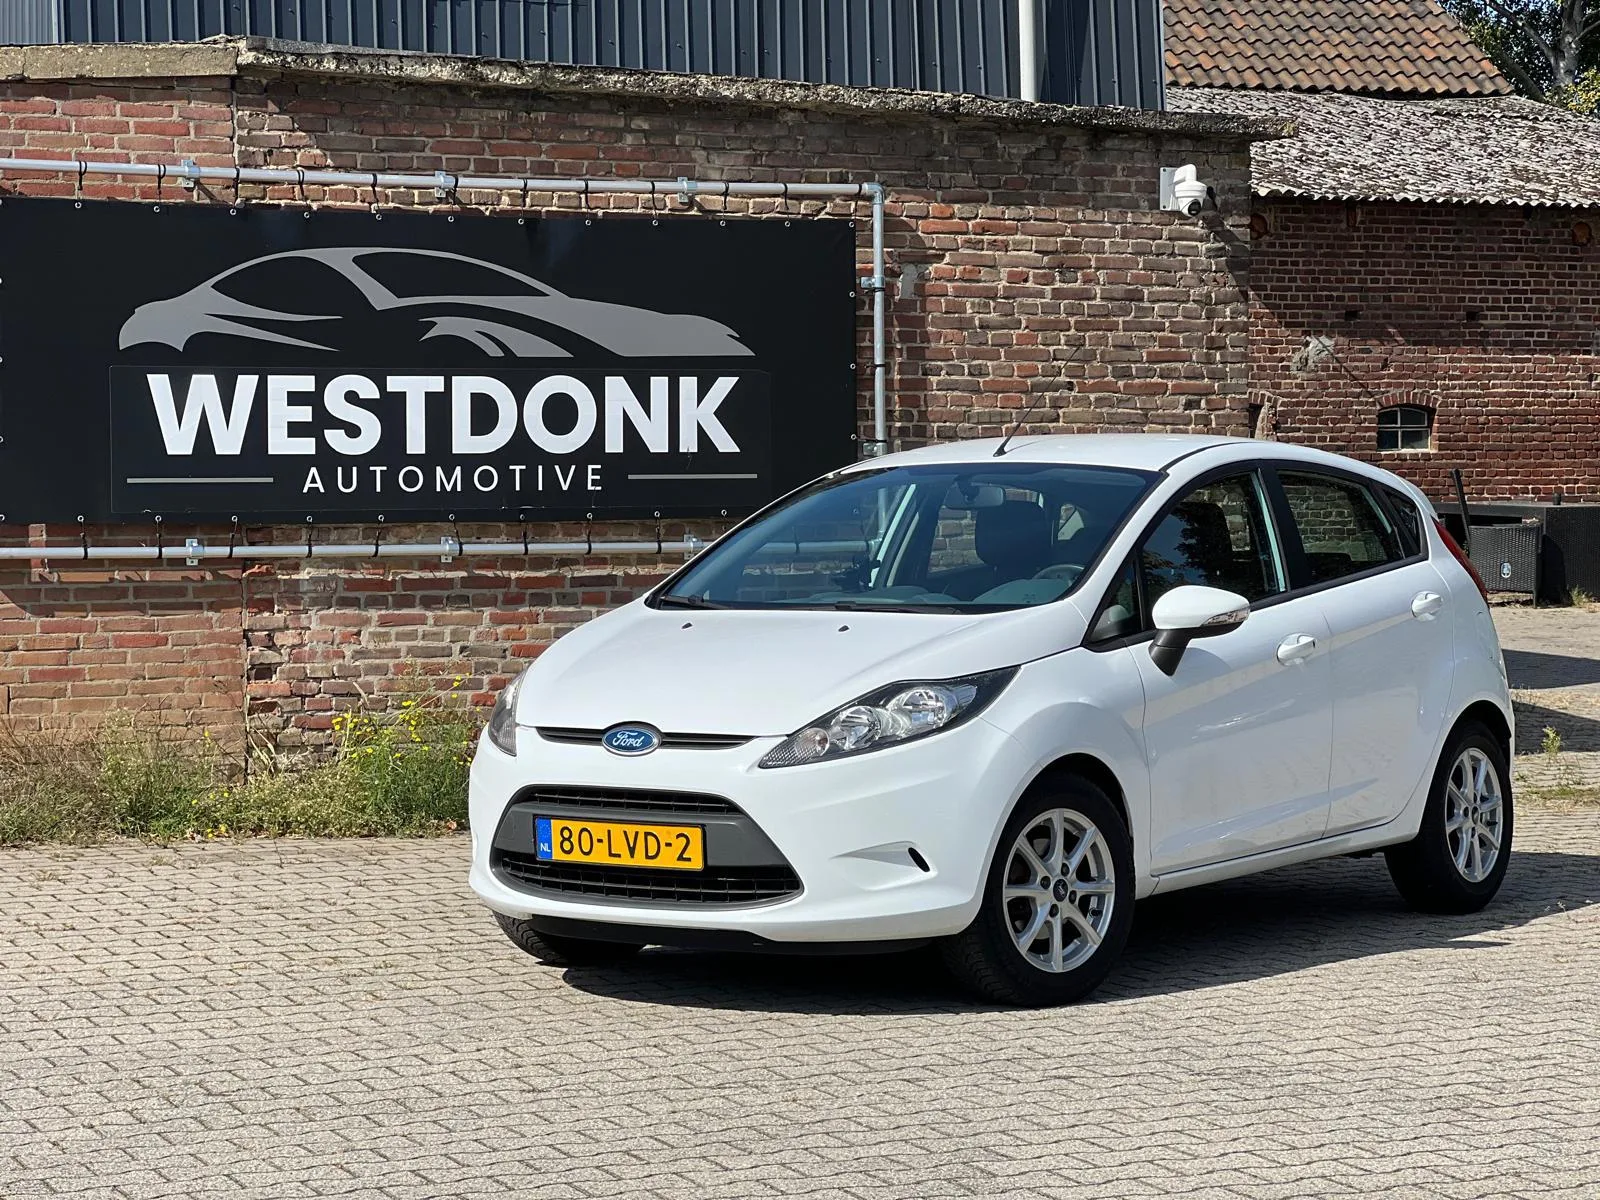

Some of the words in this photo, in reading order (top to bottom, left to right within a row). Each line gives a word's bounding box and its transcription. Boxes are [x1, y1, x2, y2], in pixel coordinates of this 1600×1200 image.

[146, 373, 741, 456] WESTDONK
[302, 464, 603, 494] AUTOMOTIVE
[612, 731, 645, 747] Ford
[540, 842, 551, 852] NL
[559, 826, 692, 862] 80-LVD-2
